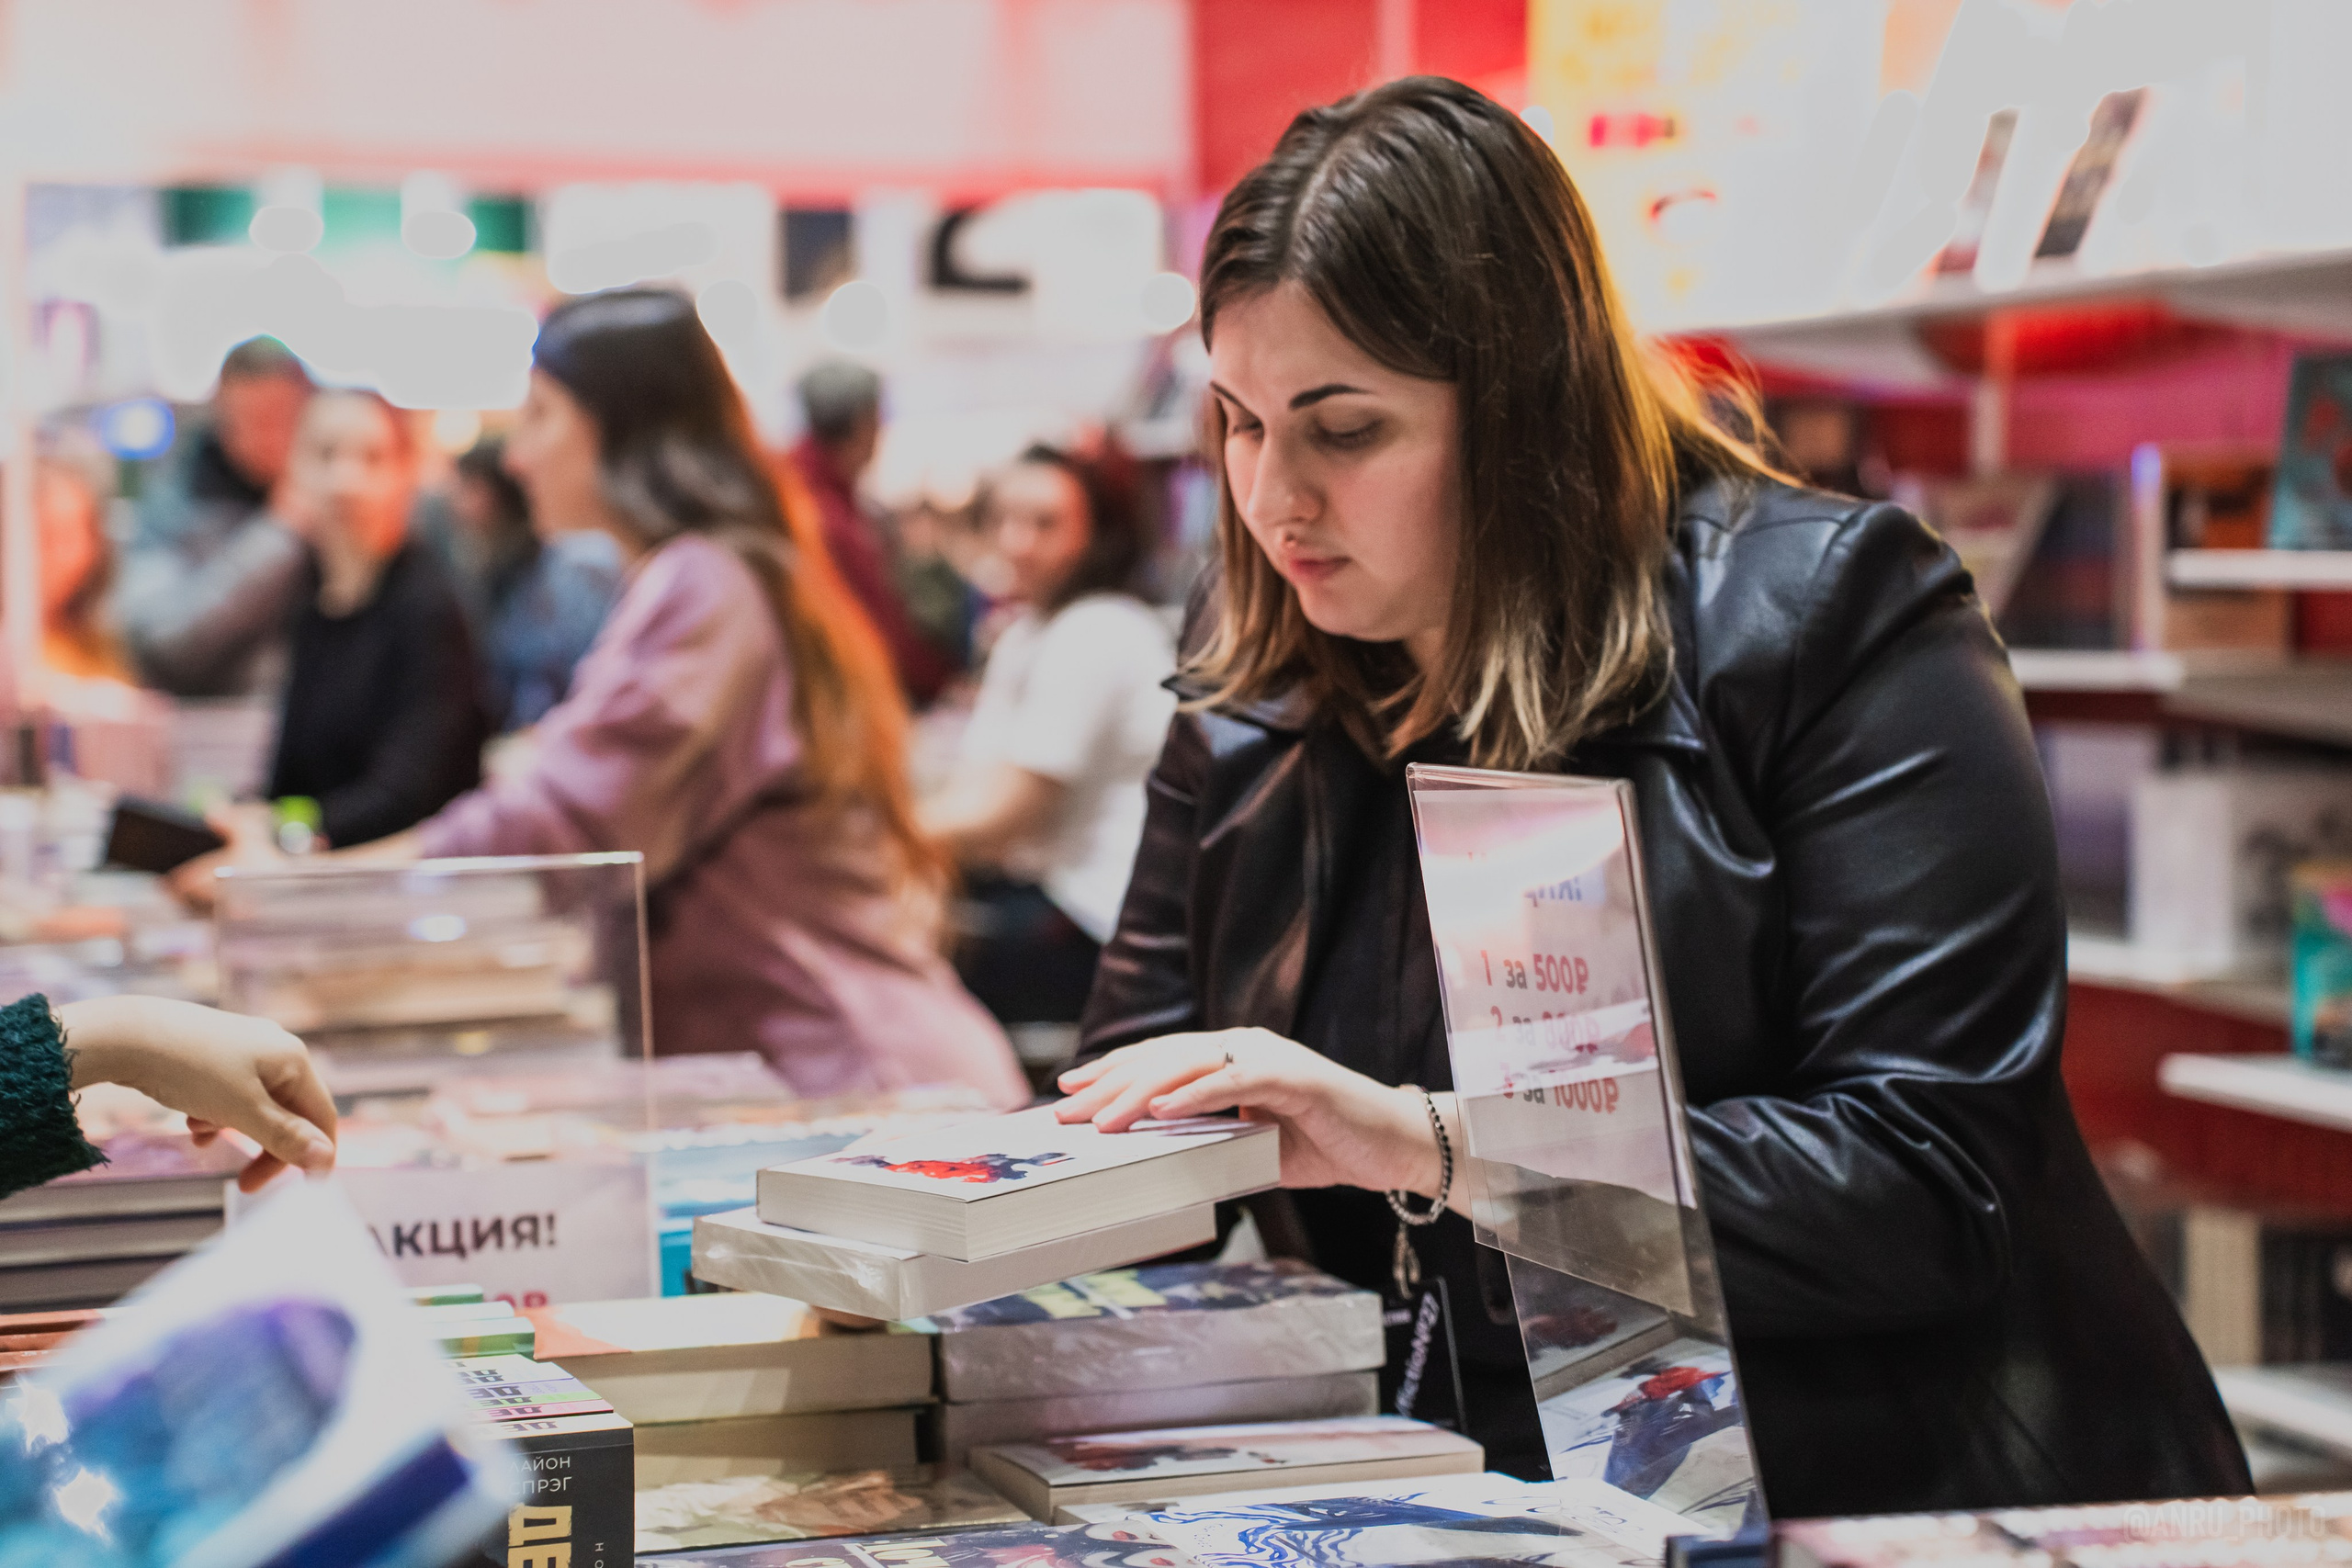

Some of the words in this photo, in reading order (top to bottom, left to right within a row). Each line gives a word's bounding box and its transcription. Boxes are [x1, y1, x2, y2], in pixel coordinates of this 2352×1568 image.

[1480, 950, 1492, 987] 1
[1503, 959, 1528, 989] за
[368, 1213, 556, 1260] КЦИЯ!
